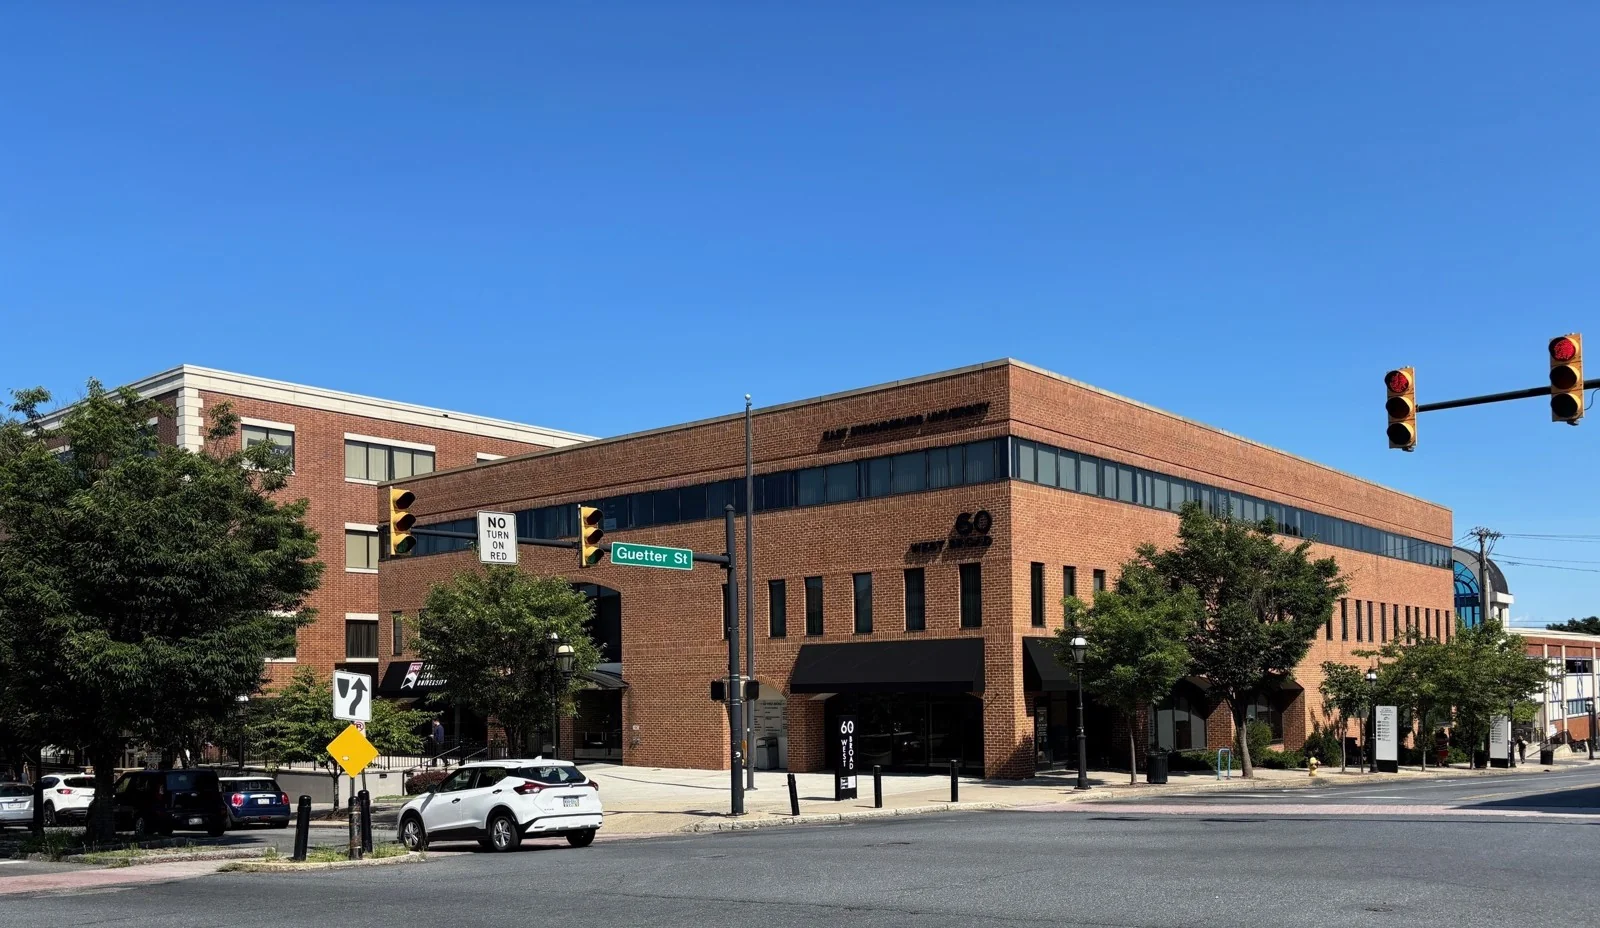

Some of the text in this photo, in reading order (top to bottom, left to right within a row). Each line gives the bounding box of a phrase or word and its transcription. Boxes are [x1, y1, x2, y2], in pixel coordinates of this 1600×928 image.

[487, 516, 506, 529] NO
[956, 510, 993, 536] 60
[487, 530, 510, 540] TURN
[492, 541, 505, 550] ON
[490, 552, 508, 560] RED
[616, 547, 688, 565] Guetter St
[840, 720, 854, 734] 60
